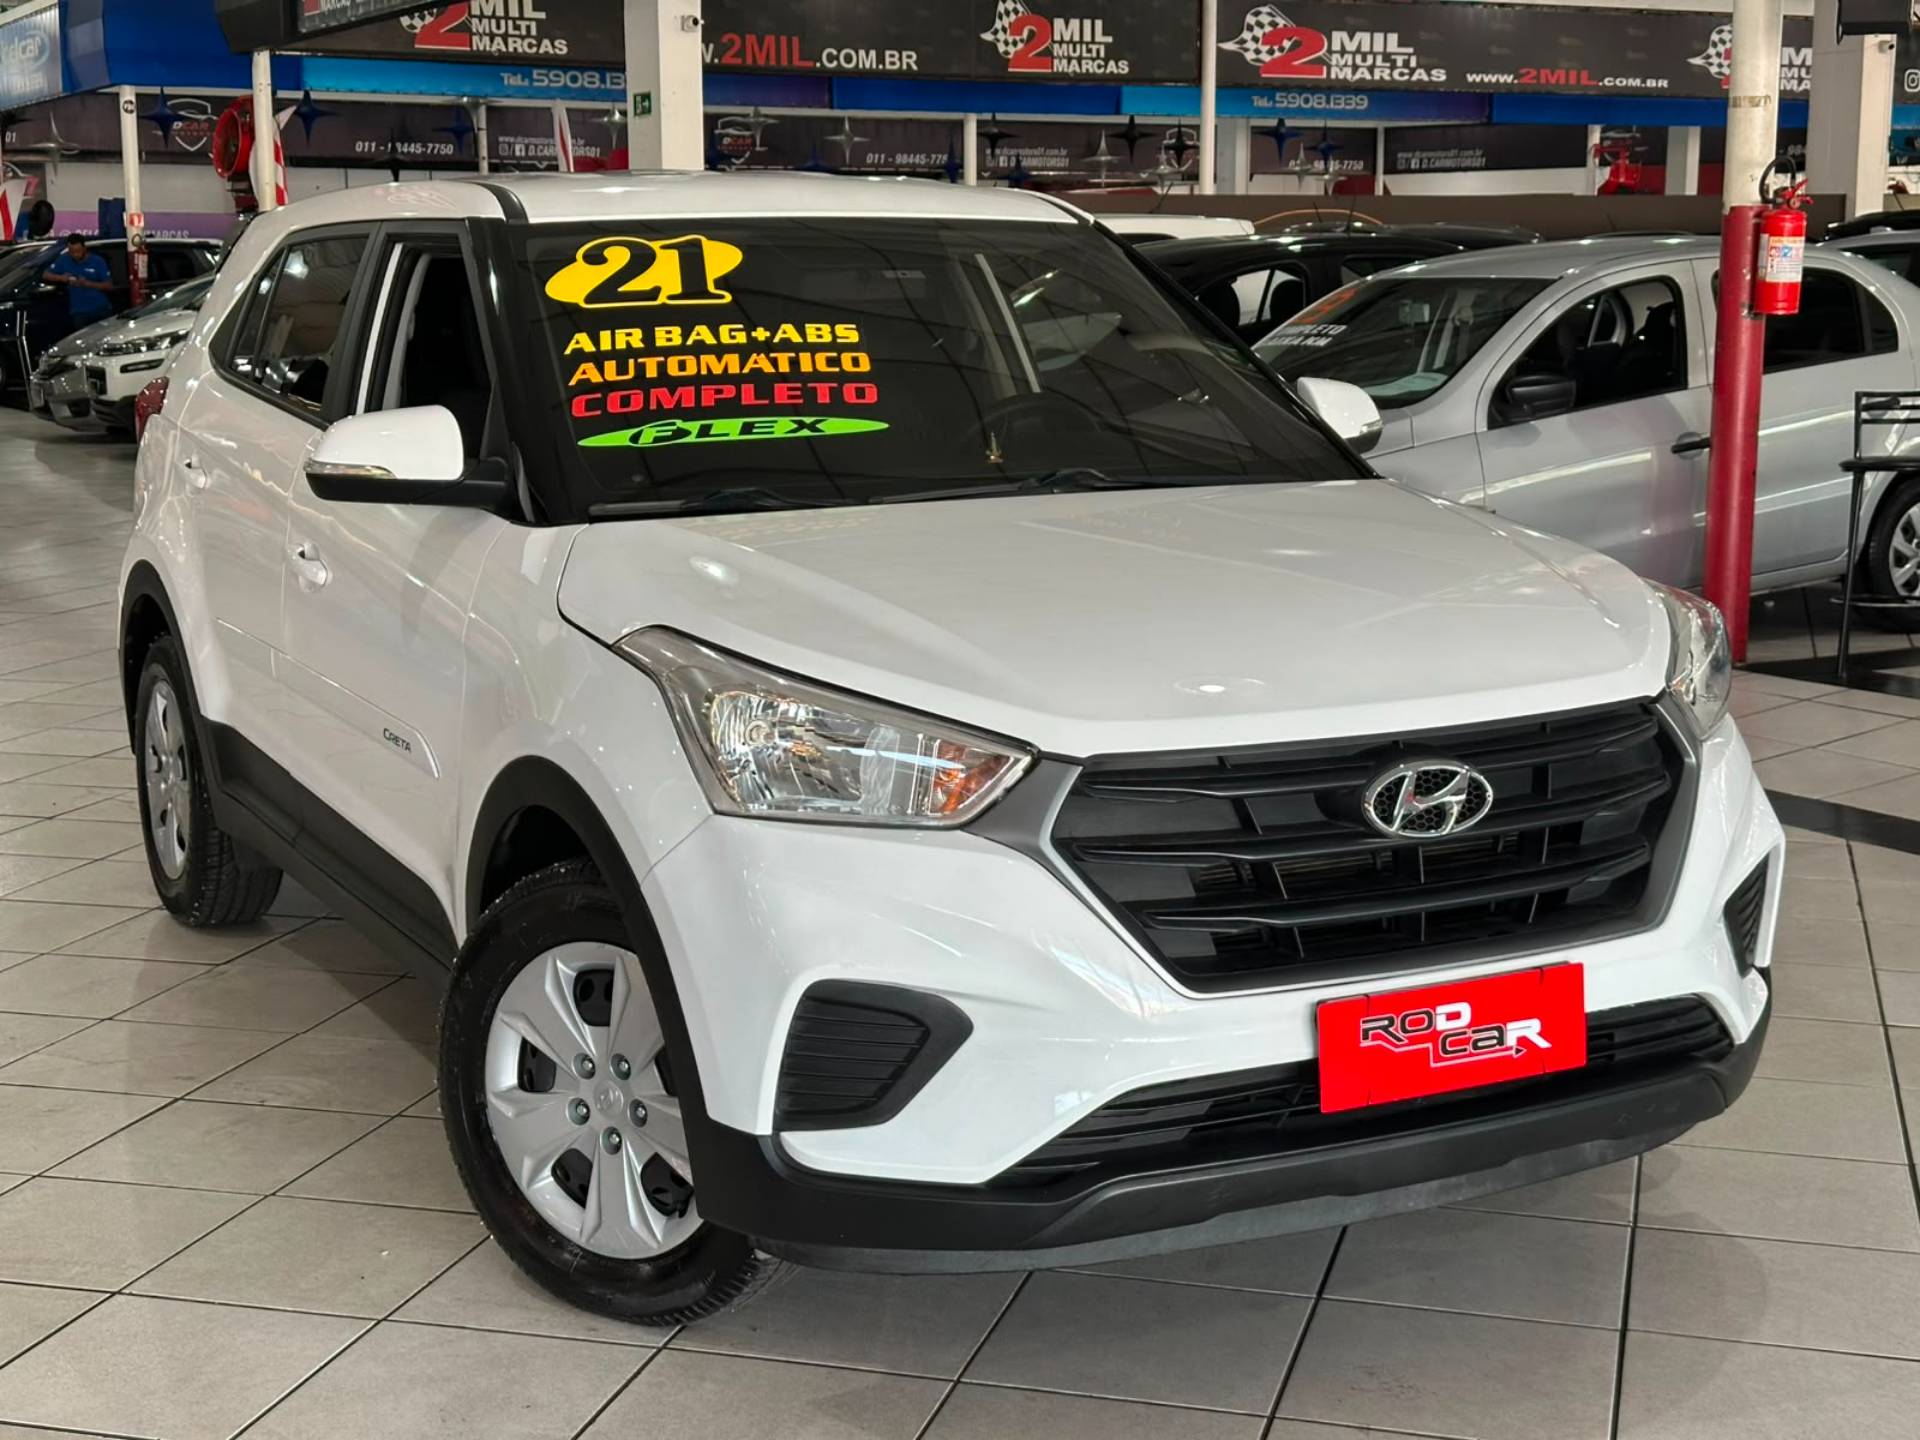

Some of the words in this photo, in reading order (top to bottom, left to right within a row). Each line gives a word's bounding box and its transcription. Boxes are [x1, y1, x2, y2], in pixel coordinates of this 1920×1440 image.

[470, 0, 547, 19] MIL
[472, 18, 537, 36] MULTI
[472, 35, 568, 55] MARCAS
[1008, 14, 1052, 72] 2
[1052, 18, 1113, 43] MIL
[1053, 43, 1105, 58] MULTI
[1259, 26, 1328, 78] 2
[1331, 31, 1414, 53] MIL
[1053, 59, 1129, 74] MARCAS
[1331, 53, 1417, 67] MULTI
[532, 69, 625, 90] 5908.13
[1330, 66, 1447, 82] MARCAS
[1275, 91, 1369, 110] 5908.1339
[355, 141, 377, 153] 011
[866, 152, 885, 165] 011
[895, 152, 949, 165] 98445-775
[578, 236, 732, 308] 21
[564, 328, 644, 354] AIR
[571, 382, 878, 418] COMPLETO
[629, 418, 830, 447] FLEX
[383, 727, 412, 754] CRETA
[1360, 1001, 1472, 1046] ROD
